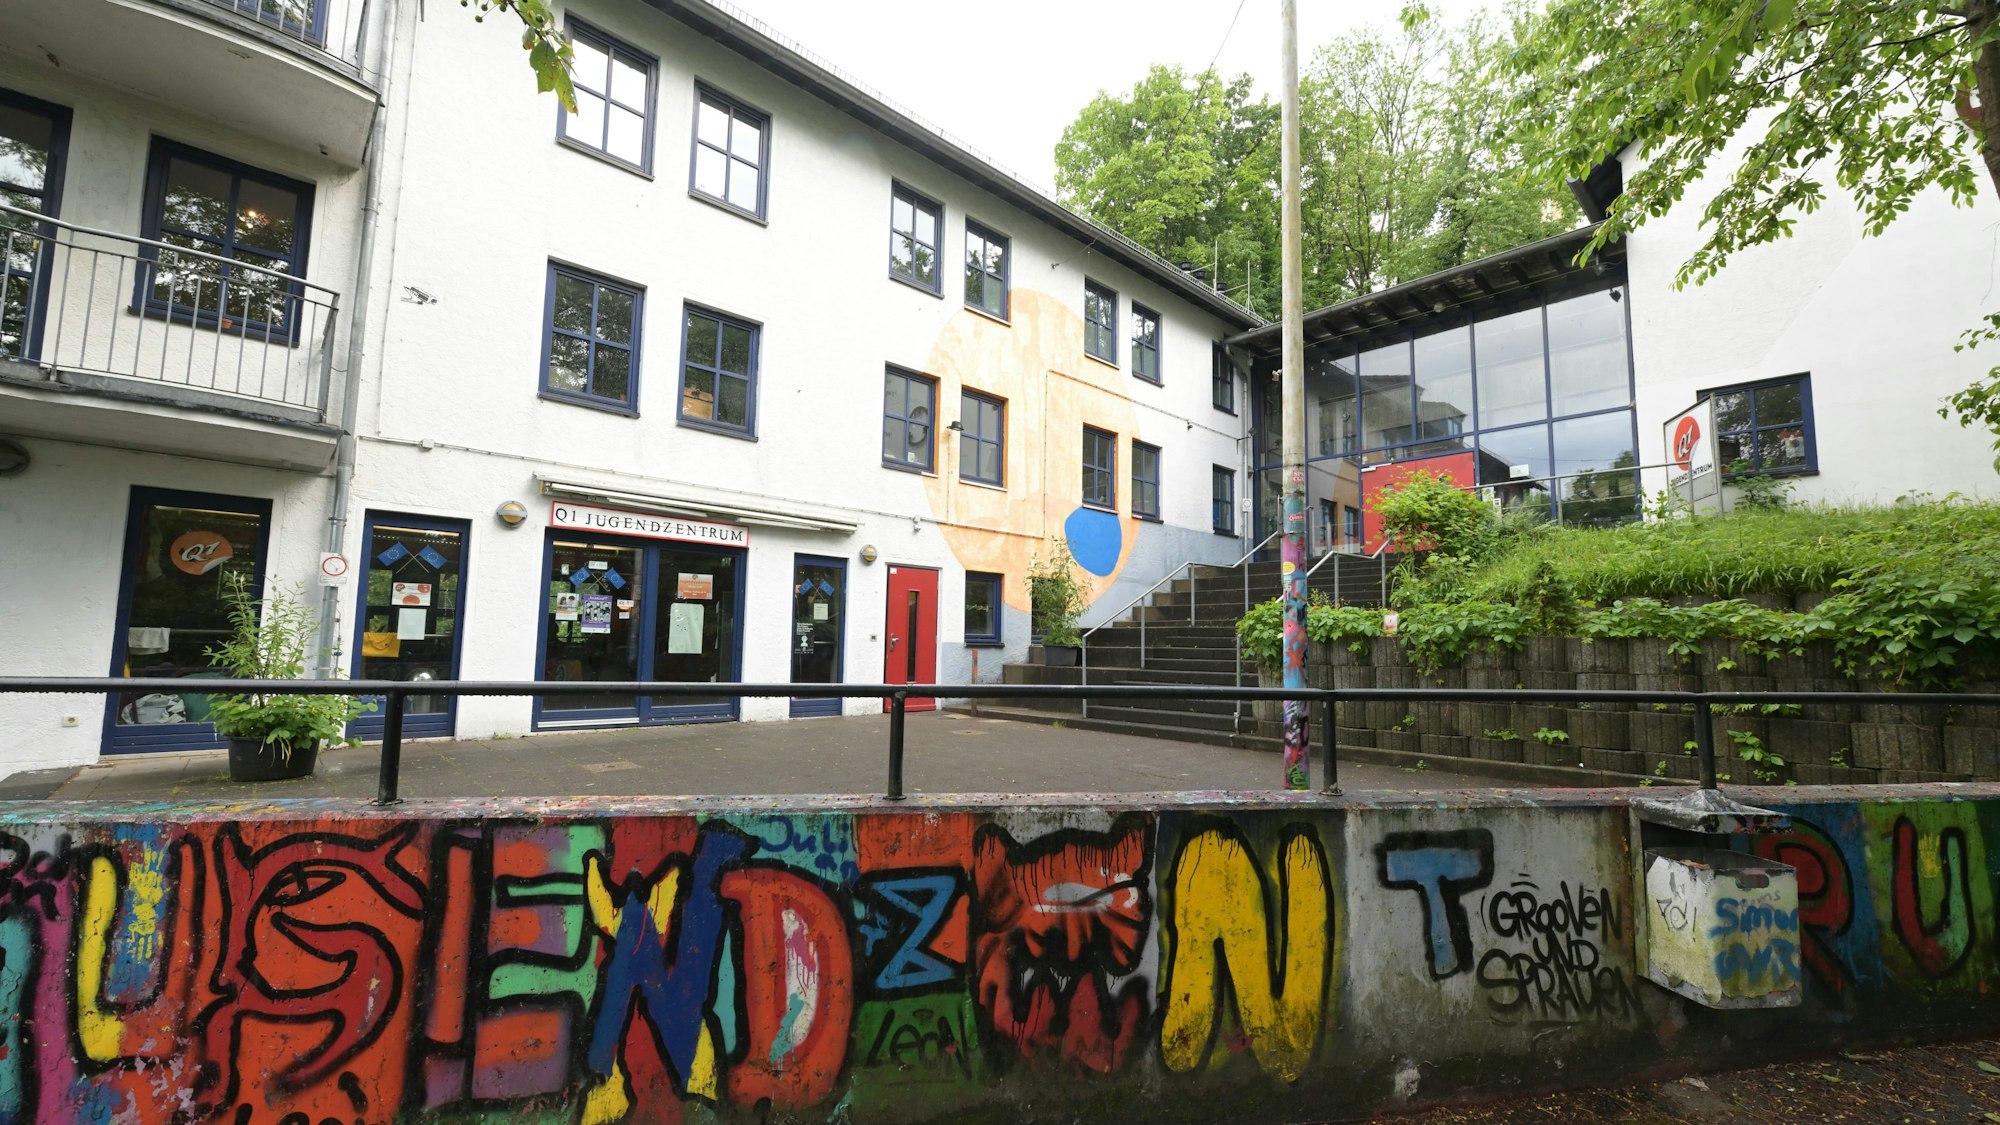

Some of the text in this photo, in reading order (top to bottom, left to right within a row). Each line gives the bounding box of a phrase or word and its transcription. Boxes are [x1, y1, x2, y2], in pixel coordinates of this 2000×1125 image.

[555, 507, 743, 542] Q1 JUGENDZENTRUM
[181, 540, 221, 563] Q1
[1532, 930, 1600, 974] UND
